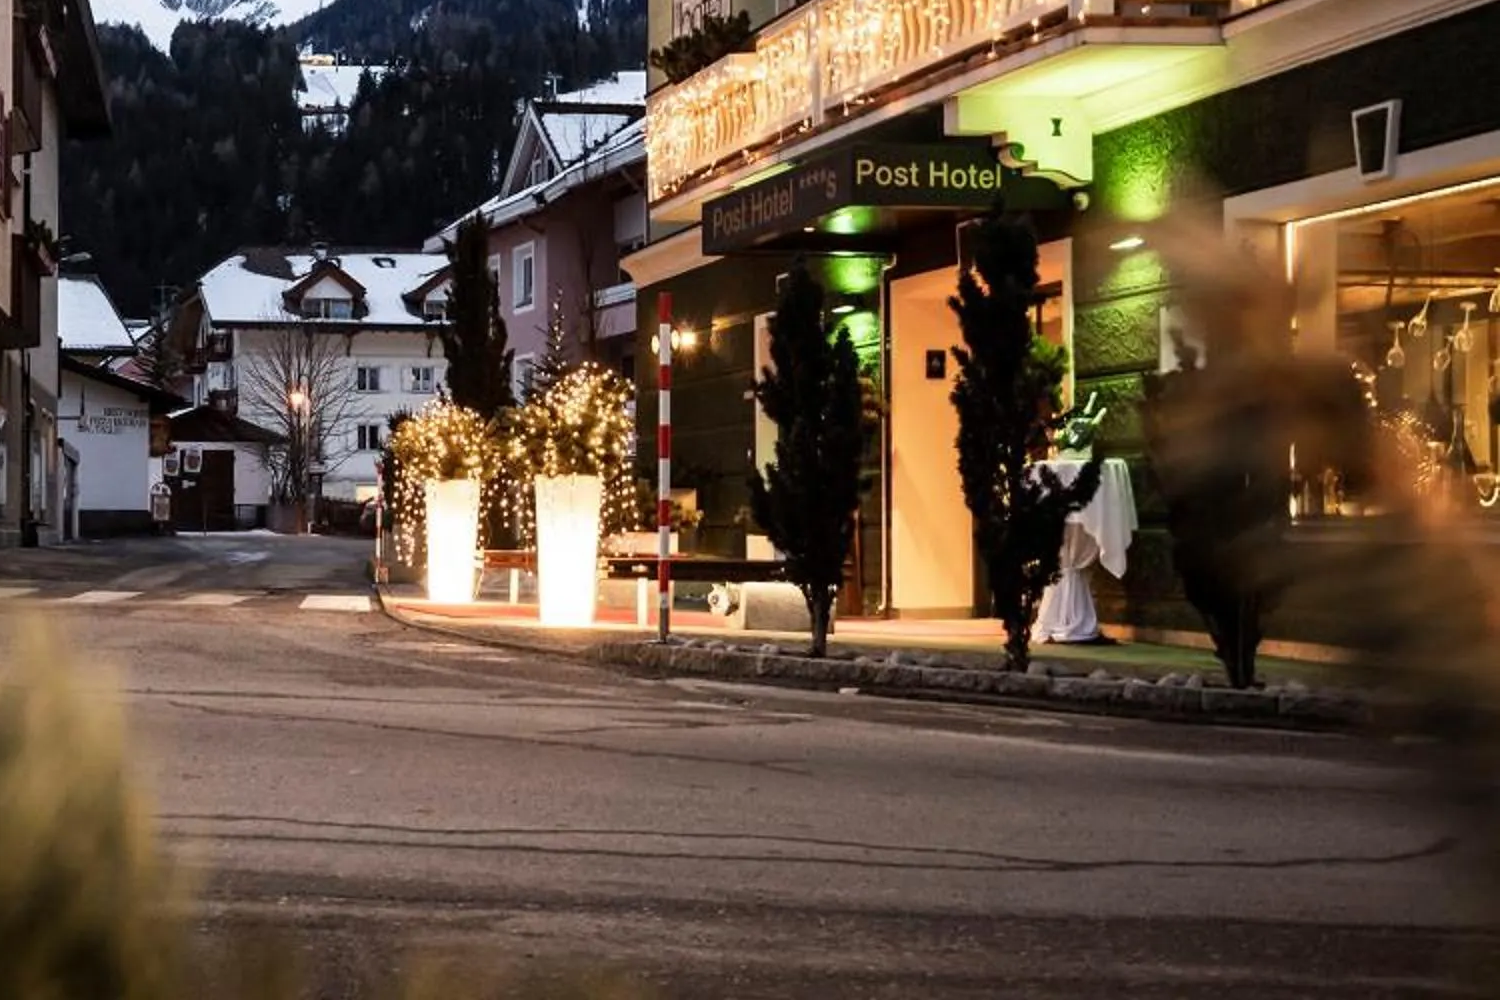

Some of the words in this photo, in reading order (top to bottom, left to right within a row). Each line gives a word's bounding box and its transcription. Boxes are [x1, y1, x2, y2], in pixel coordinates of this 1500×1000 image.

[856, 159, 919, 187] Post
[928, 161, 1001, 189] Hotel
[712, 195, 746, 239] Post
[751, 178, 794, 227] Hotel
